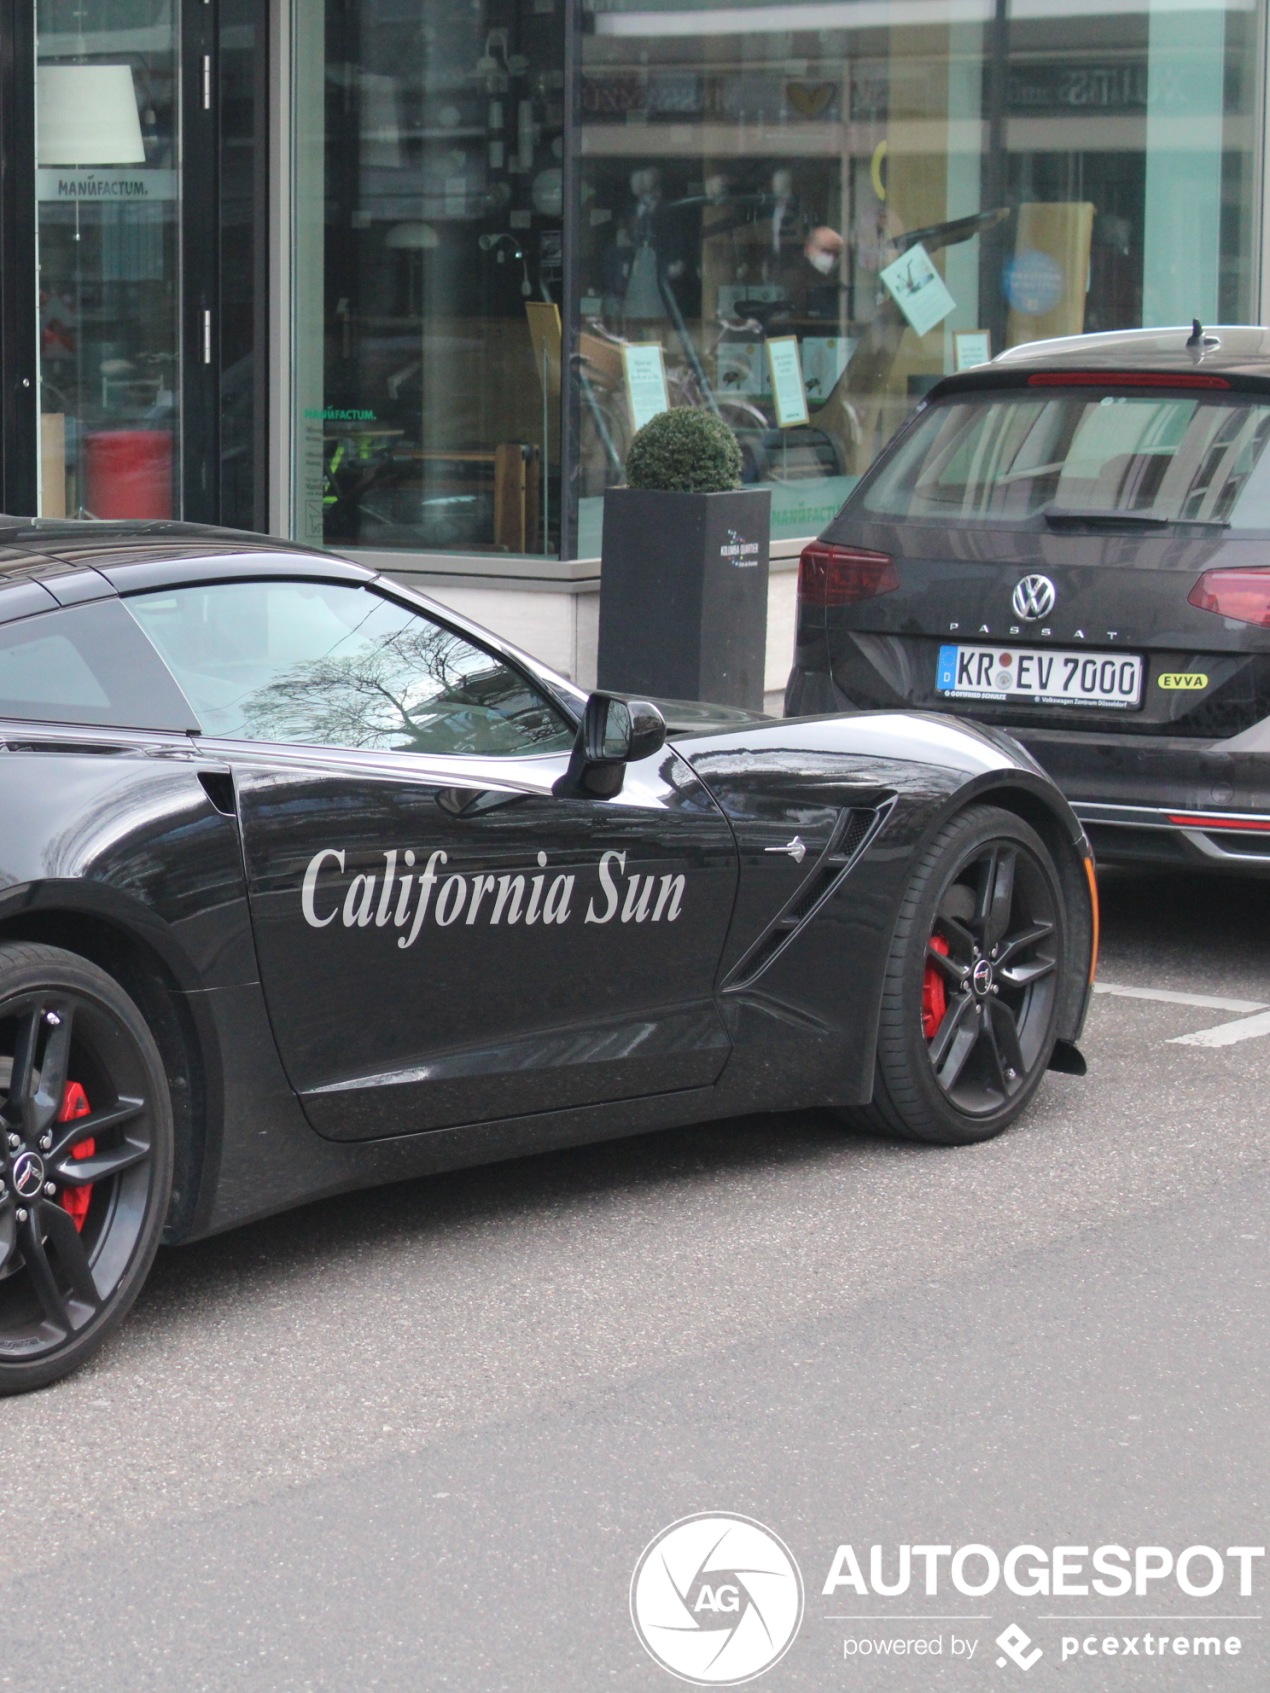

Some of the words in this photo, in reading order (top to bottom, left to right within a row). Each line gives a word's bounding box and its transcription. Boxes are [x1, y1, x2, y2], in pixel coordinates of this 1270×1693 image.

[948, 622, 1118, 641] PASSAT
[942, 672, 951, 683] D
[956, 651, 995, 686] KR
[1016, 654, 1055, 690] EV
[1063, 656, 1135, 696] 7000
[1164, 674, 1203, 688] EVVA
[1041, 696, 1073, 705] Volkswagen
[1073, 698, 1097, 706] Zentrum
[1097, 699, 1128, 708] Düsseldorf
[301, 848, 575, 950] California
[585, 849, 687, 925] Sun
